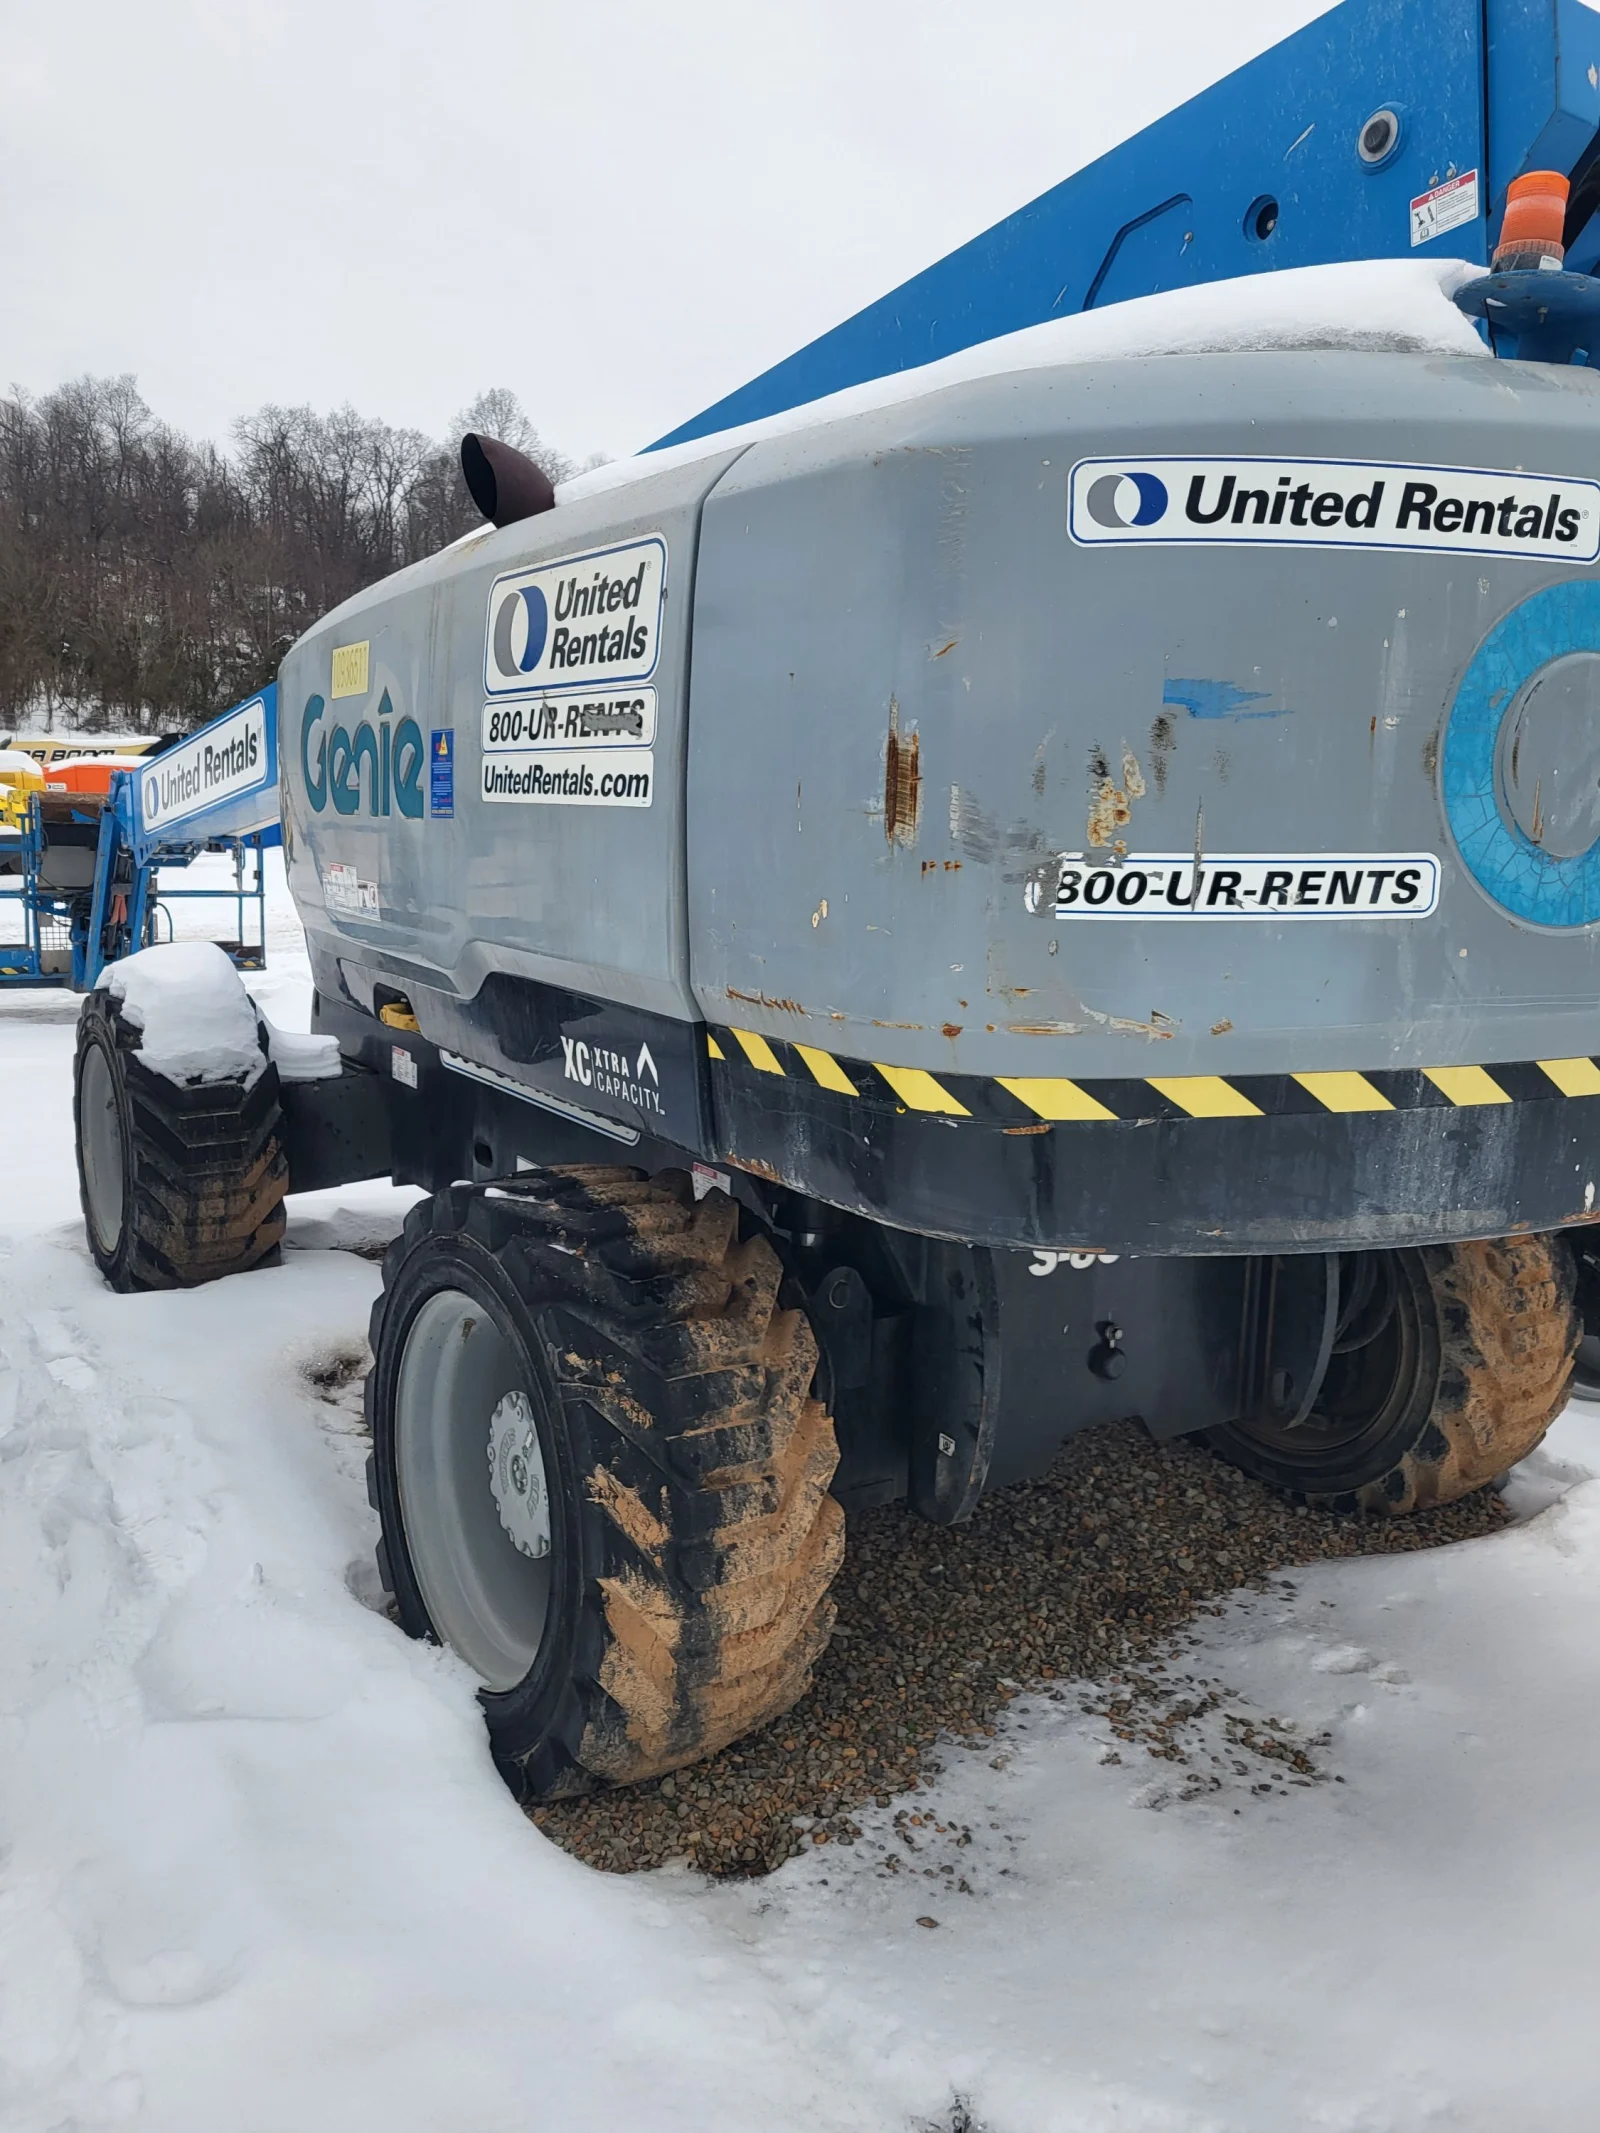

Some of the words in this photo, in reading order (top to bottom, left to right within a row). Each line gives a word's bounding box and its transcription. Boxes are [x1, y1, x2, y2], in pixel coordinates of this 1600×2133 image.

[1434, 180, 1460, 198] DANGER
[1185, 475, 1386, 528] United
[1395, 481, 1581, 542] Rentals
[554, 561, 646, 622] United
[549, 614, 648, 669] Rentals
[161, 752, 200, 811] United
[204, 723, 258, 789] Rentals
[301, 686, 424, 819] Genie
[484, 764, 649, 798] UnitedRentals.com
[1055, 868, 1422, 906] 800-UR-RENTS
[560, 1035, 592, 1087] XC
[593, 1046, 630, 1078] XTRA
[597, 1071, 660, 1113] CAPACITY
